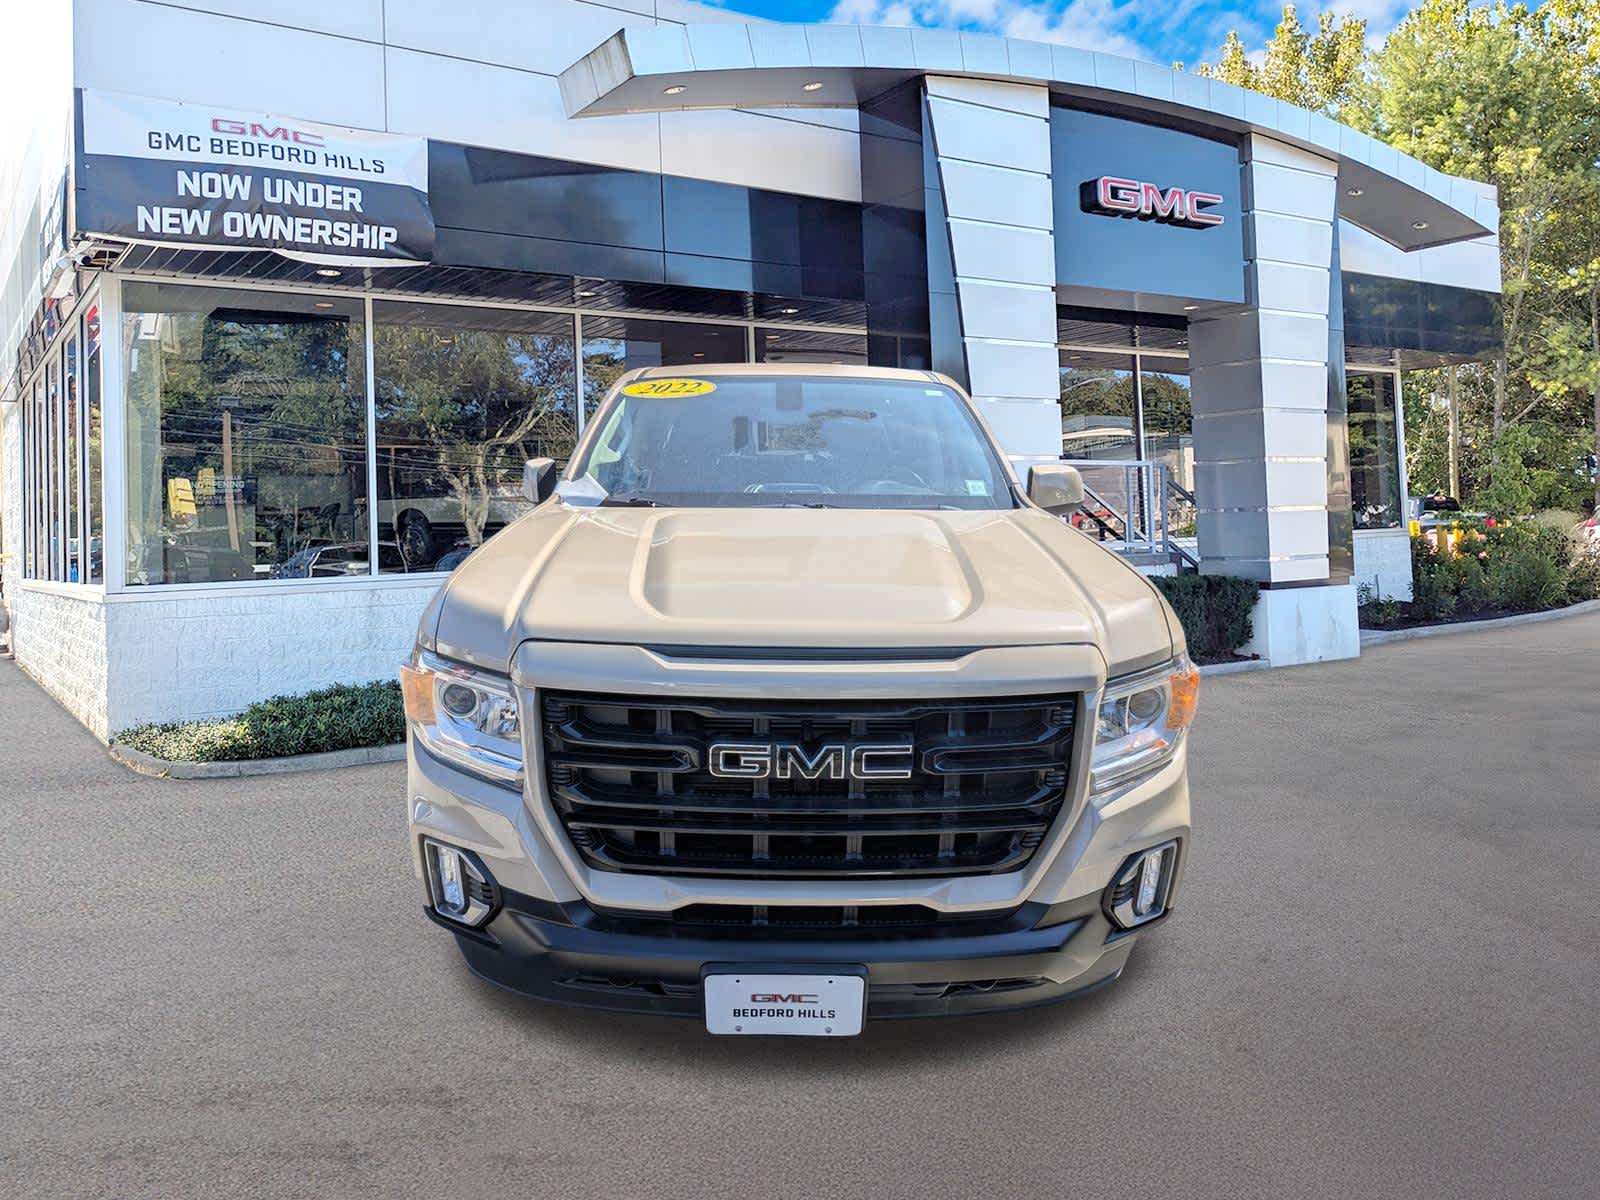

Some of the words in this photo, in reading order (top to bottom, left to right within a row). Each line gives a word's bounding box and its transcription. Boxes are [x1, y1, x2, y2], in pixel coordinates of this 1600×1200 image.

[210, 118, 325, 147] GMC
[148, 131, 201, 152] GMC
[210, 138, 316, 165] BEDFORD
[324, 153, 385, 174] HILLS
[177, 170, 251, 201] NOW
[264, 178, 363, 212] UNDER
[1098, 175, 1225, 225] GMC
[137, 206, 211, 235] NEW
[224, 211, 398, 250] OWNERSHIP
[639, 382, 703, 394] 2022
[710, 744, 913, 779] GMC
[733, 1008, 794, 1018] BEDFORD
[798, 1009, 836, 1019] HILLS
[751, 994, 819, 1004] GMC
